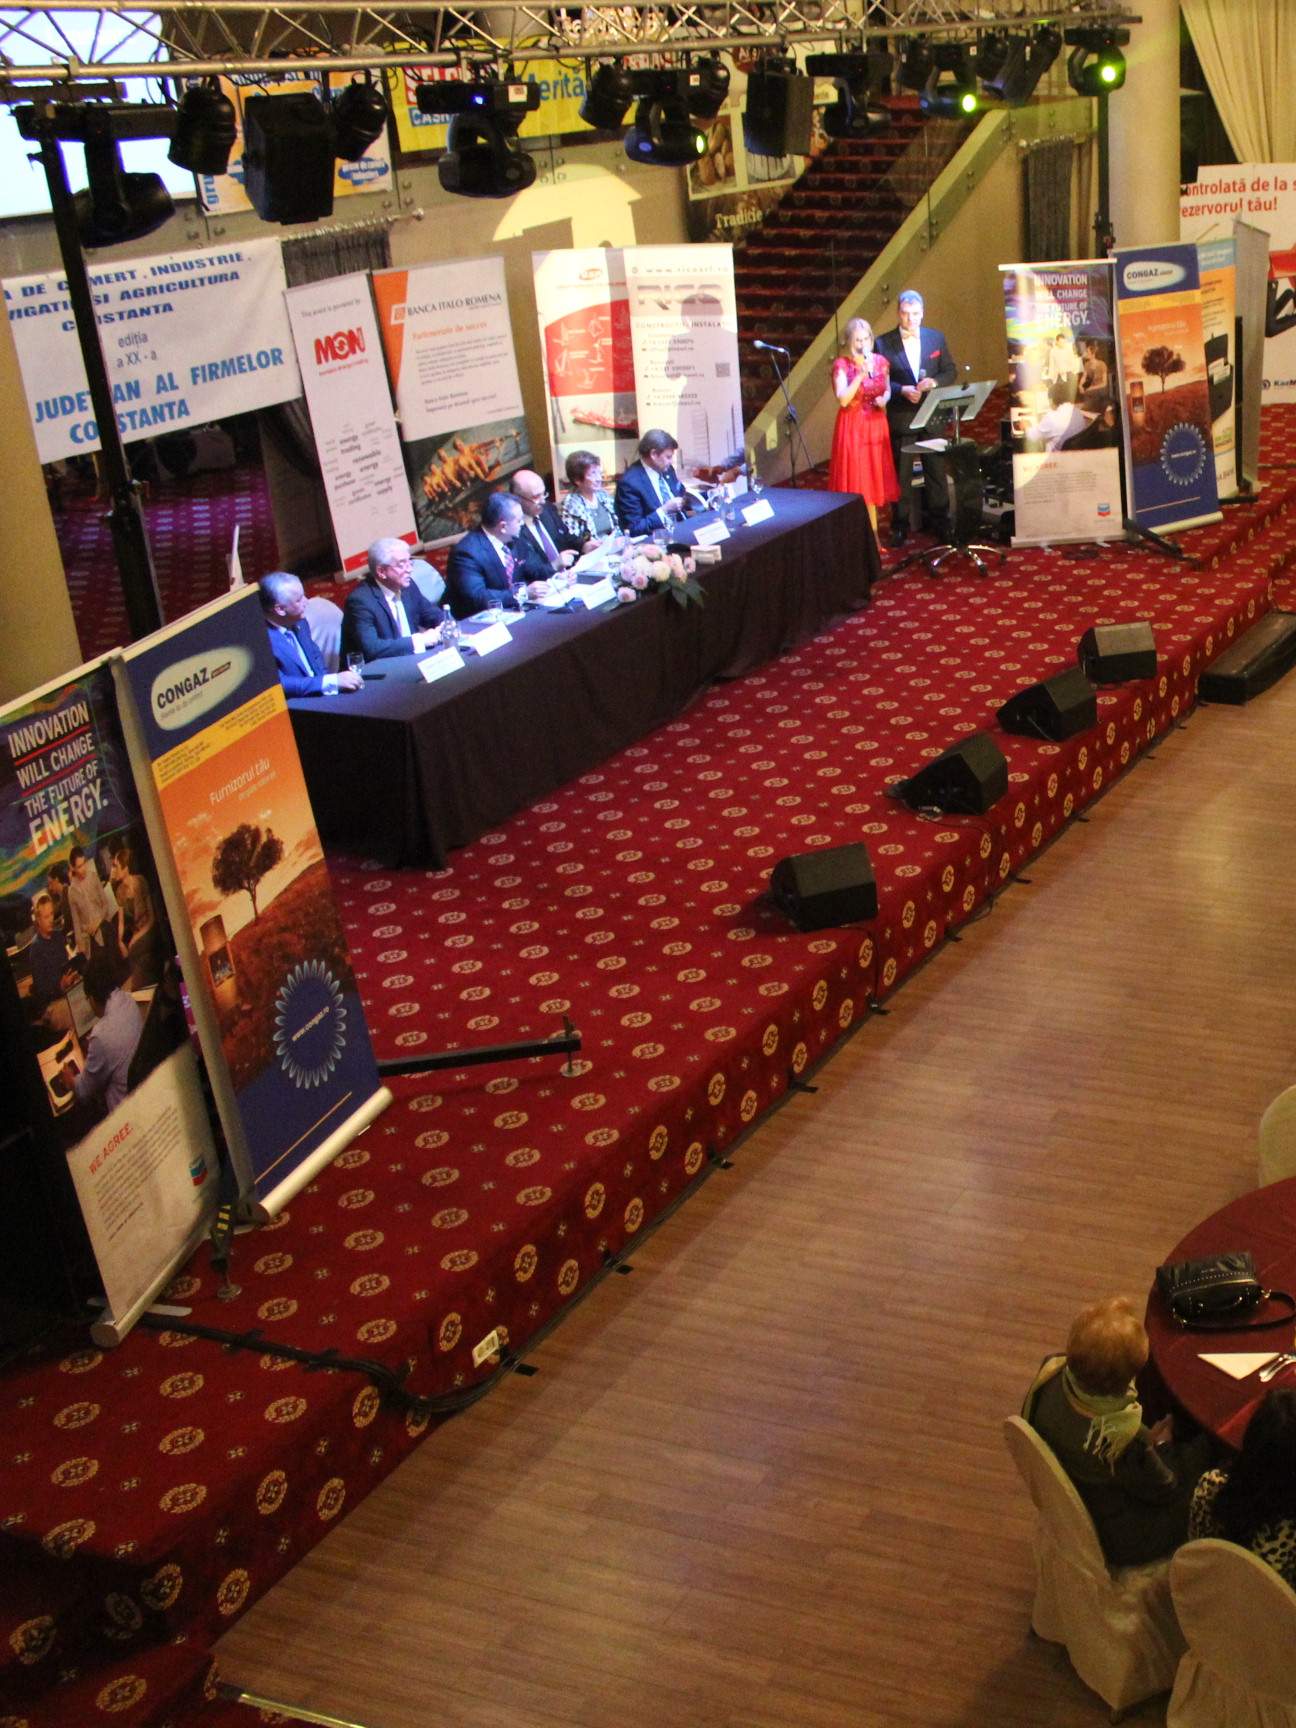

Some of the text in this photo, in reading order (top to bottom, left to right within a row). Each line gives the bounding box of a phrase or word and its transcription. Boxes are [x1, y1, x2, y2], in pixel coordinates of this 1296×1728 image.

[1181, 198, 1243, 217] ezervorul
[1186, 178, 1246, 197] ontrolată
[1251, 176, 1270, 192] de
[1274, 176, 1288, 191] la
[21, 283, 46, 298] DE
[150, 252, 243, 277] INDUSTRIE
[120, 271, 241, 301] AGRICULTURA
[1126, 268, 1160, 280] CONGAZ
[156, 372, 179, 395] AL
[190, 348, 284, 386] FIRMELOR
[69, 399, 190, 444] COSTANTA
[157, 667, 210, 709] CONGAZ
[8, 701, 90, 759] INNOVATION
[17, 732, 96, 790] WILL CHANGE
[24, 759, 99, 818] THE FUTURE OF
[29, 778, 110, 855] ENERGY.
